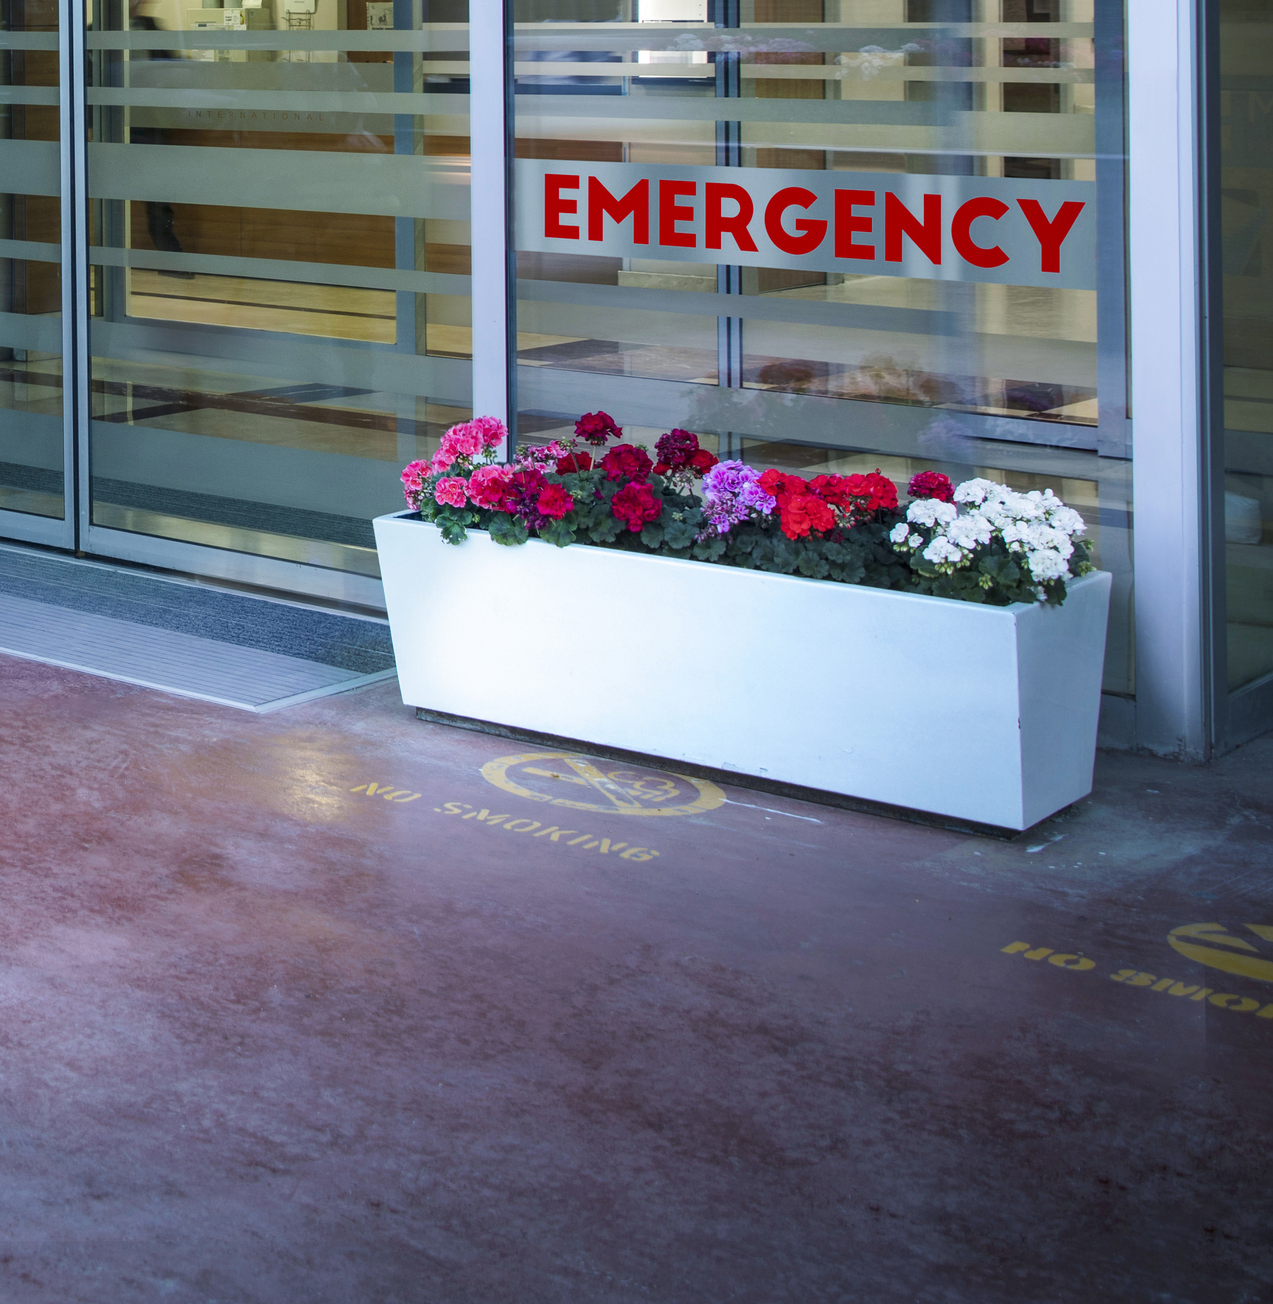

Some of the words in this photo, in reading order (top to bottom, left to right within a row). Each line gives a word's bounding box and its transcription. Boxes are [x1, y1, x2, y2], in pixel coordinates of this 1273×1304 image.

[188, 110, 325, 122] INTERNATIONAL
[543, 173, 1086, 274] EMERGENCY
[350, 782, 422, 802] NO
[433, 802, 660, 861] SMOKING
[1000, 940, 1096, 970] NO
